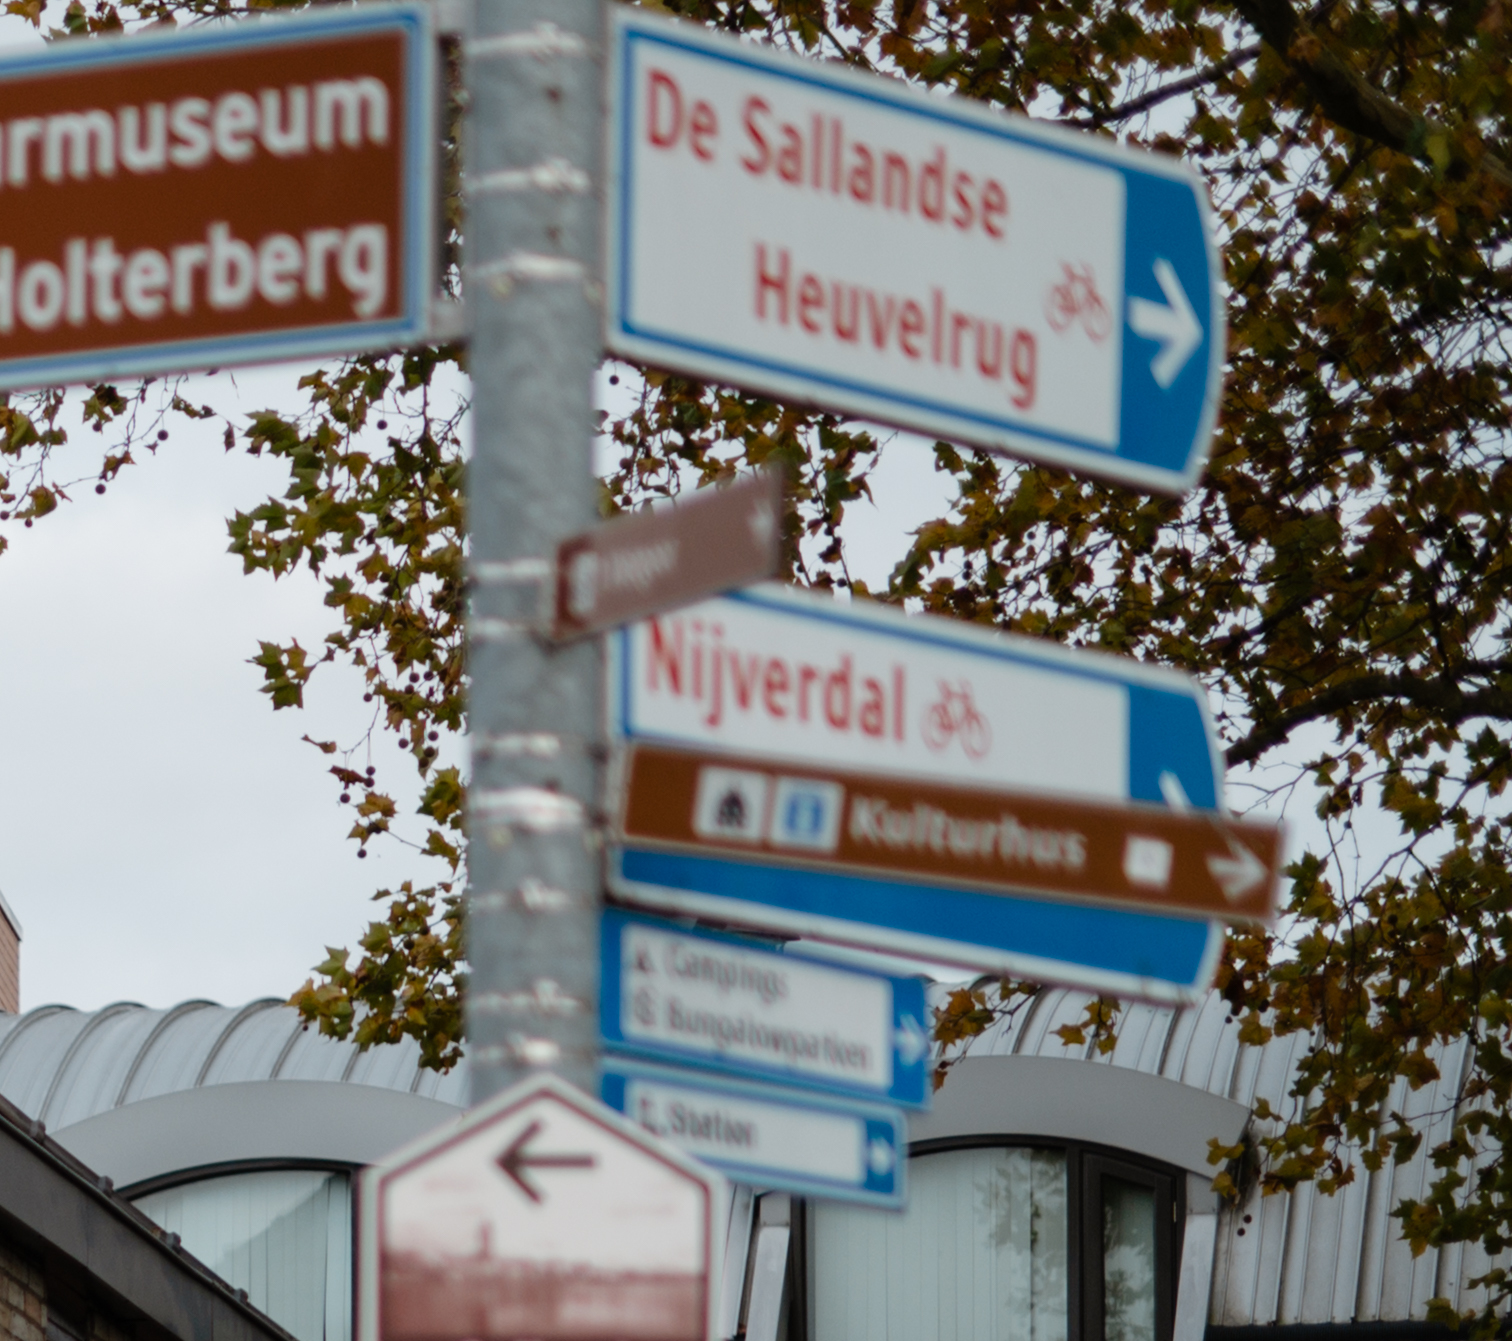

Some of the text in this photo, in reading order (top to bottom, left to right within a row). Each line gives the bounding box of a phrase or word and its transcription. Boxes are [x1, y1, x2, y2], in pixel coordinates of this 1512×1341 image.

[645, 67, 1011, 242] De Sallandse
[753, 242, 1040, 412] Heuvelrug
[644, 616, 908, 744] Nijverdal
[850, 794, 1089, 871] Kulturhus
[668, 942, 790, 1003] Campings
[669, 1105, 755, 1147] Station
